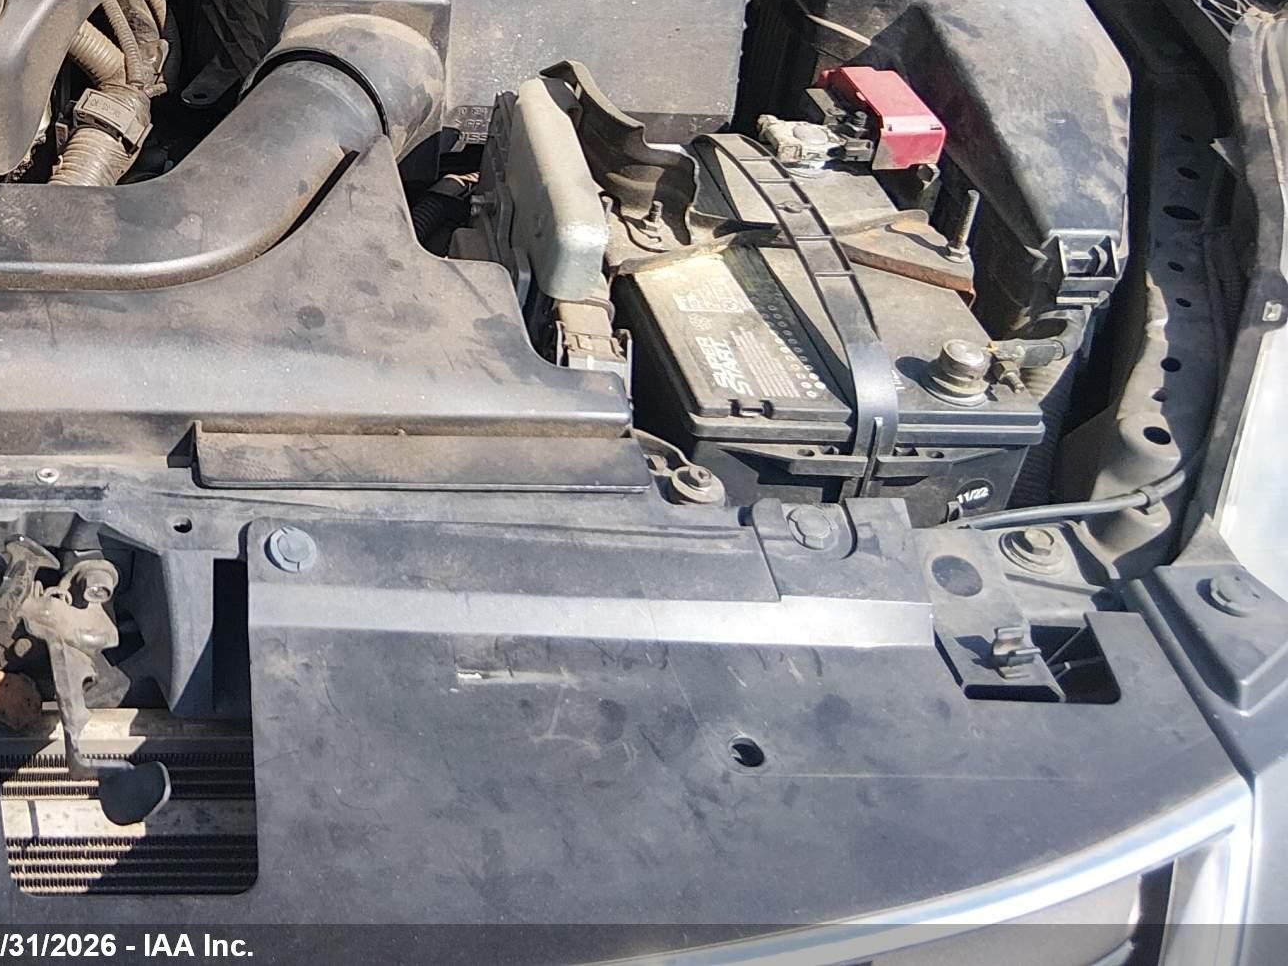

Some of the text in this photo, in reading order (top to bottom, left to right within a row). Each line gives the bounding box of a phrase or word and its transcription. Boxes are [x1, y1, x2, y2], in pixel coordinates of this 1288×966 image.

[695, 336, 729, 387] SUPER
[712, 338, 754, 396] START
[956, 487, 989, 504] 11/22
